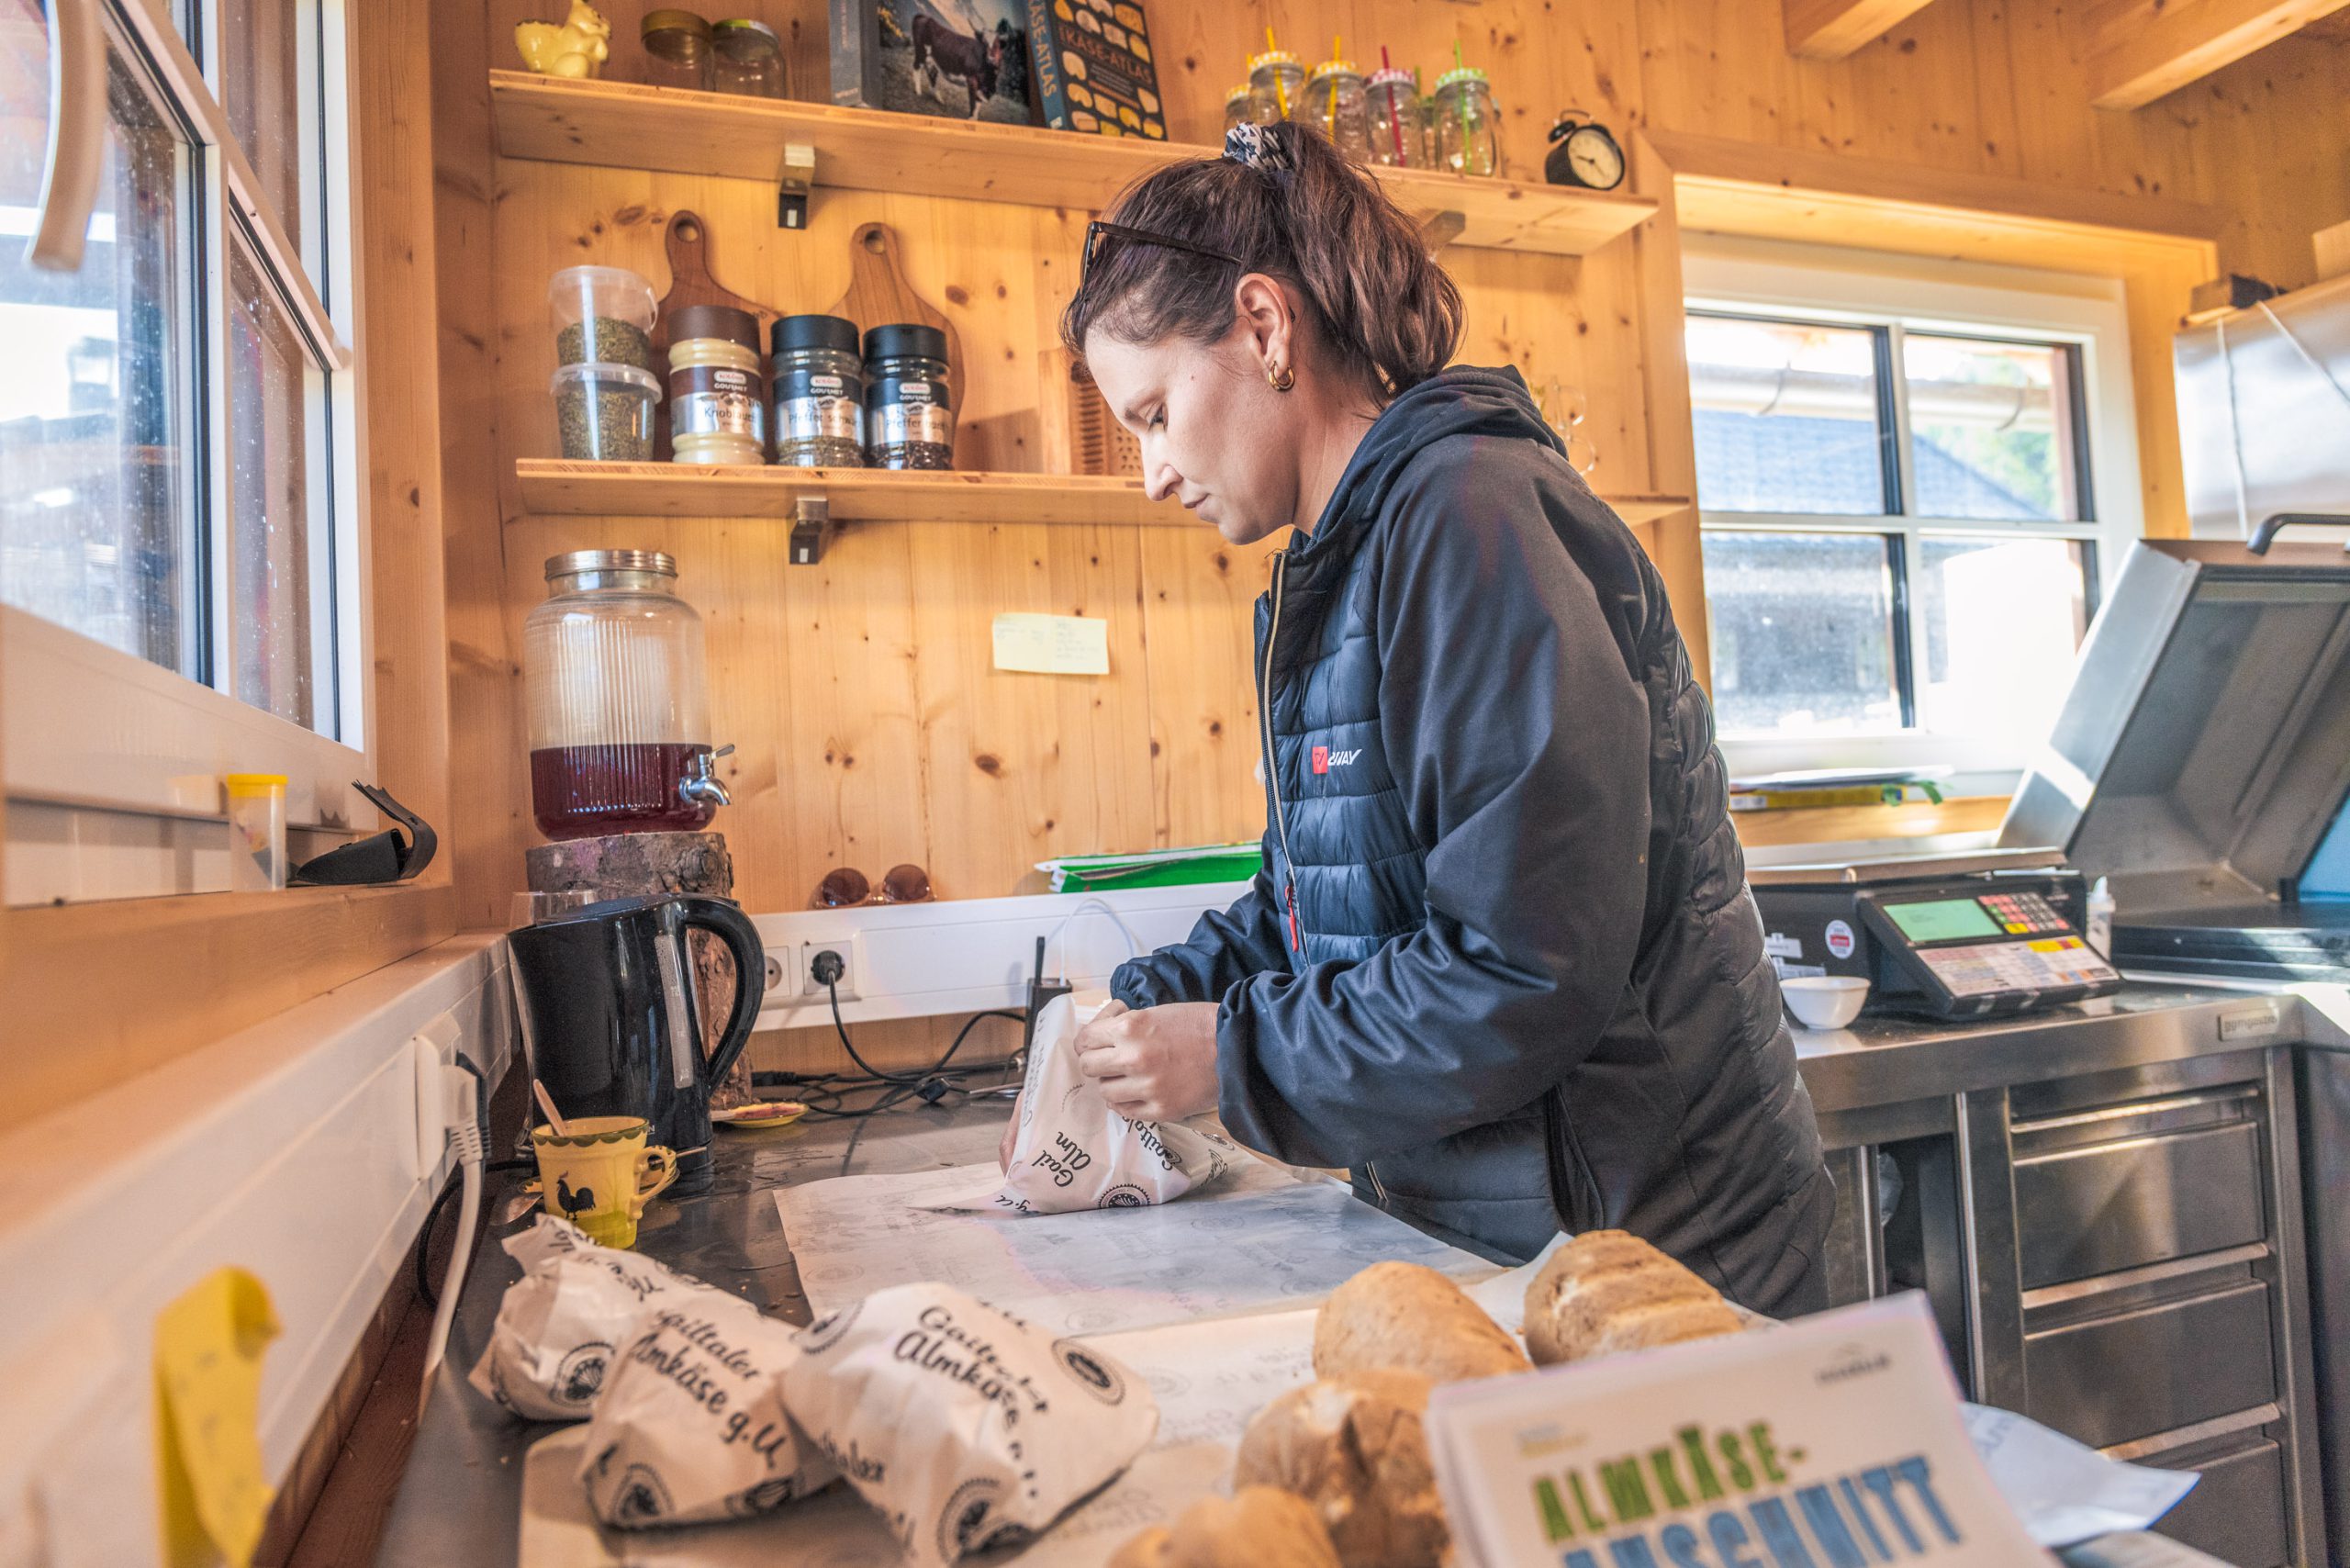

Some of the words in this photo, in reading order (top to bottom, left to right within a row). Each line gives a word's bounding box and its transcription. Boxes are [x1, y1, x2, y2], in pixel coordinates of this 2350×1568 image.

[810, 387, 844, 396] GOURMET
[886, 417, 922, 430] Pfeffer
[1563, 1453, 1964, 1568] SCHNITT
